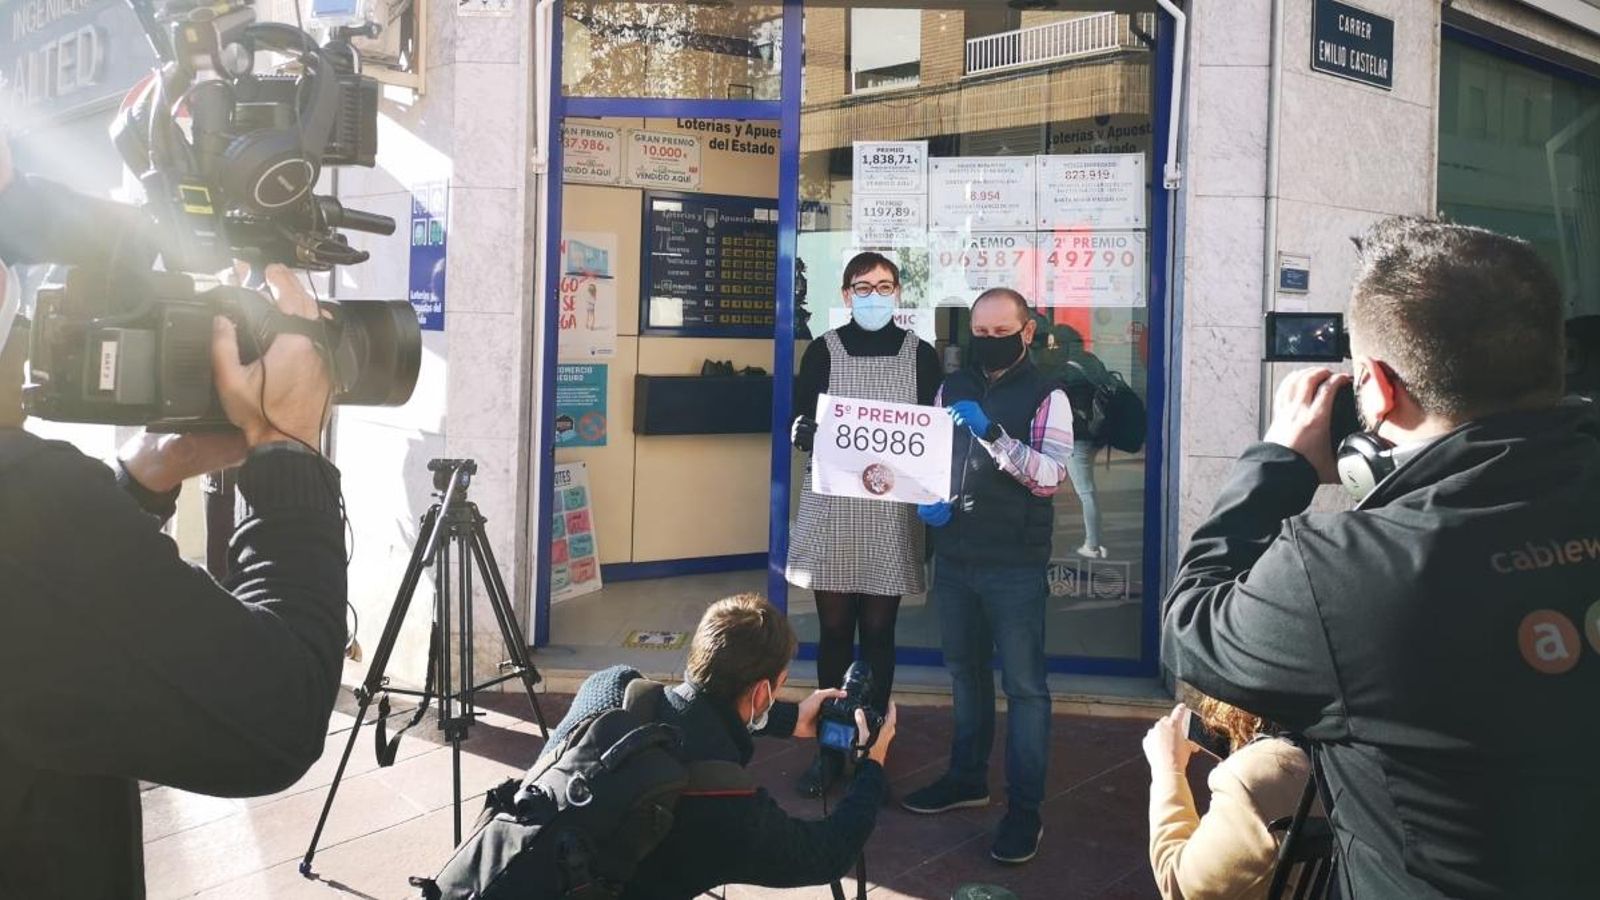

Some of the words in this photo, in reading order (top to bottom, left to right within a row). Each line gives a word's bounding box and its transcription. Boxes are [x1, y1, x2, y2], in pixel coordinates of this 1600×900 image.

[1338, 14, 1372, 40] CARRER
[1319, 39, 1347, 67] EMILIO
[1349, 49, 1389, 79] CASTELAR
[580, 129, 614, 139] PREMIO
[735, 124, 742, 137] y
[634, 134, 660, 143] GRAN
[662, 136, 695, 147] PREMIO
[708, 137, 729, 151] del
[731, 139, 775, 155] Estado
[642, 144, 682, 158] 10.000
[862, 154, 913, 166] 1,838,71
[635, 171, 670, 181] VENDIDO
[863, 207, 911, 218] 1197,89
[1072, 236, 1127, 249] PREMIO
[1046, 250, 1135, 268] 49790
[834, 403, 852, 418] 5º
[858, 406, 931, 427] PREMIO
[835, 424, 926, 458] 86986
